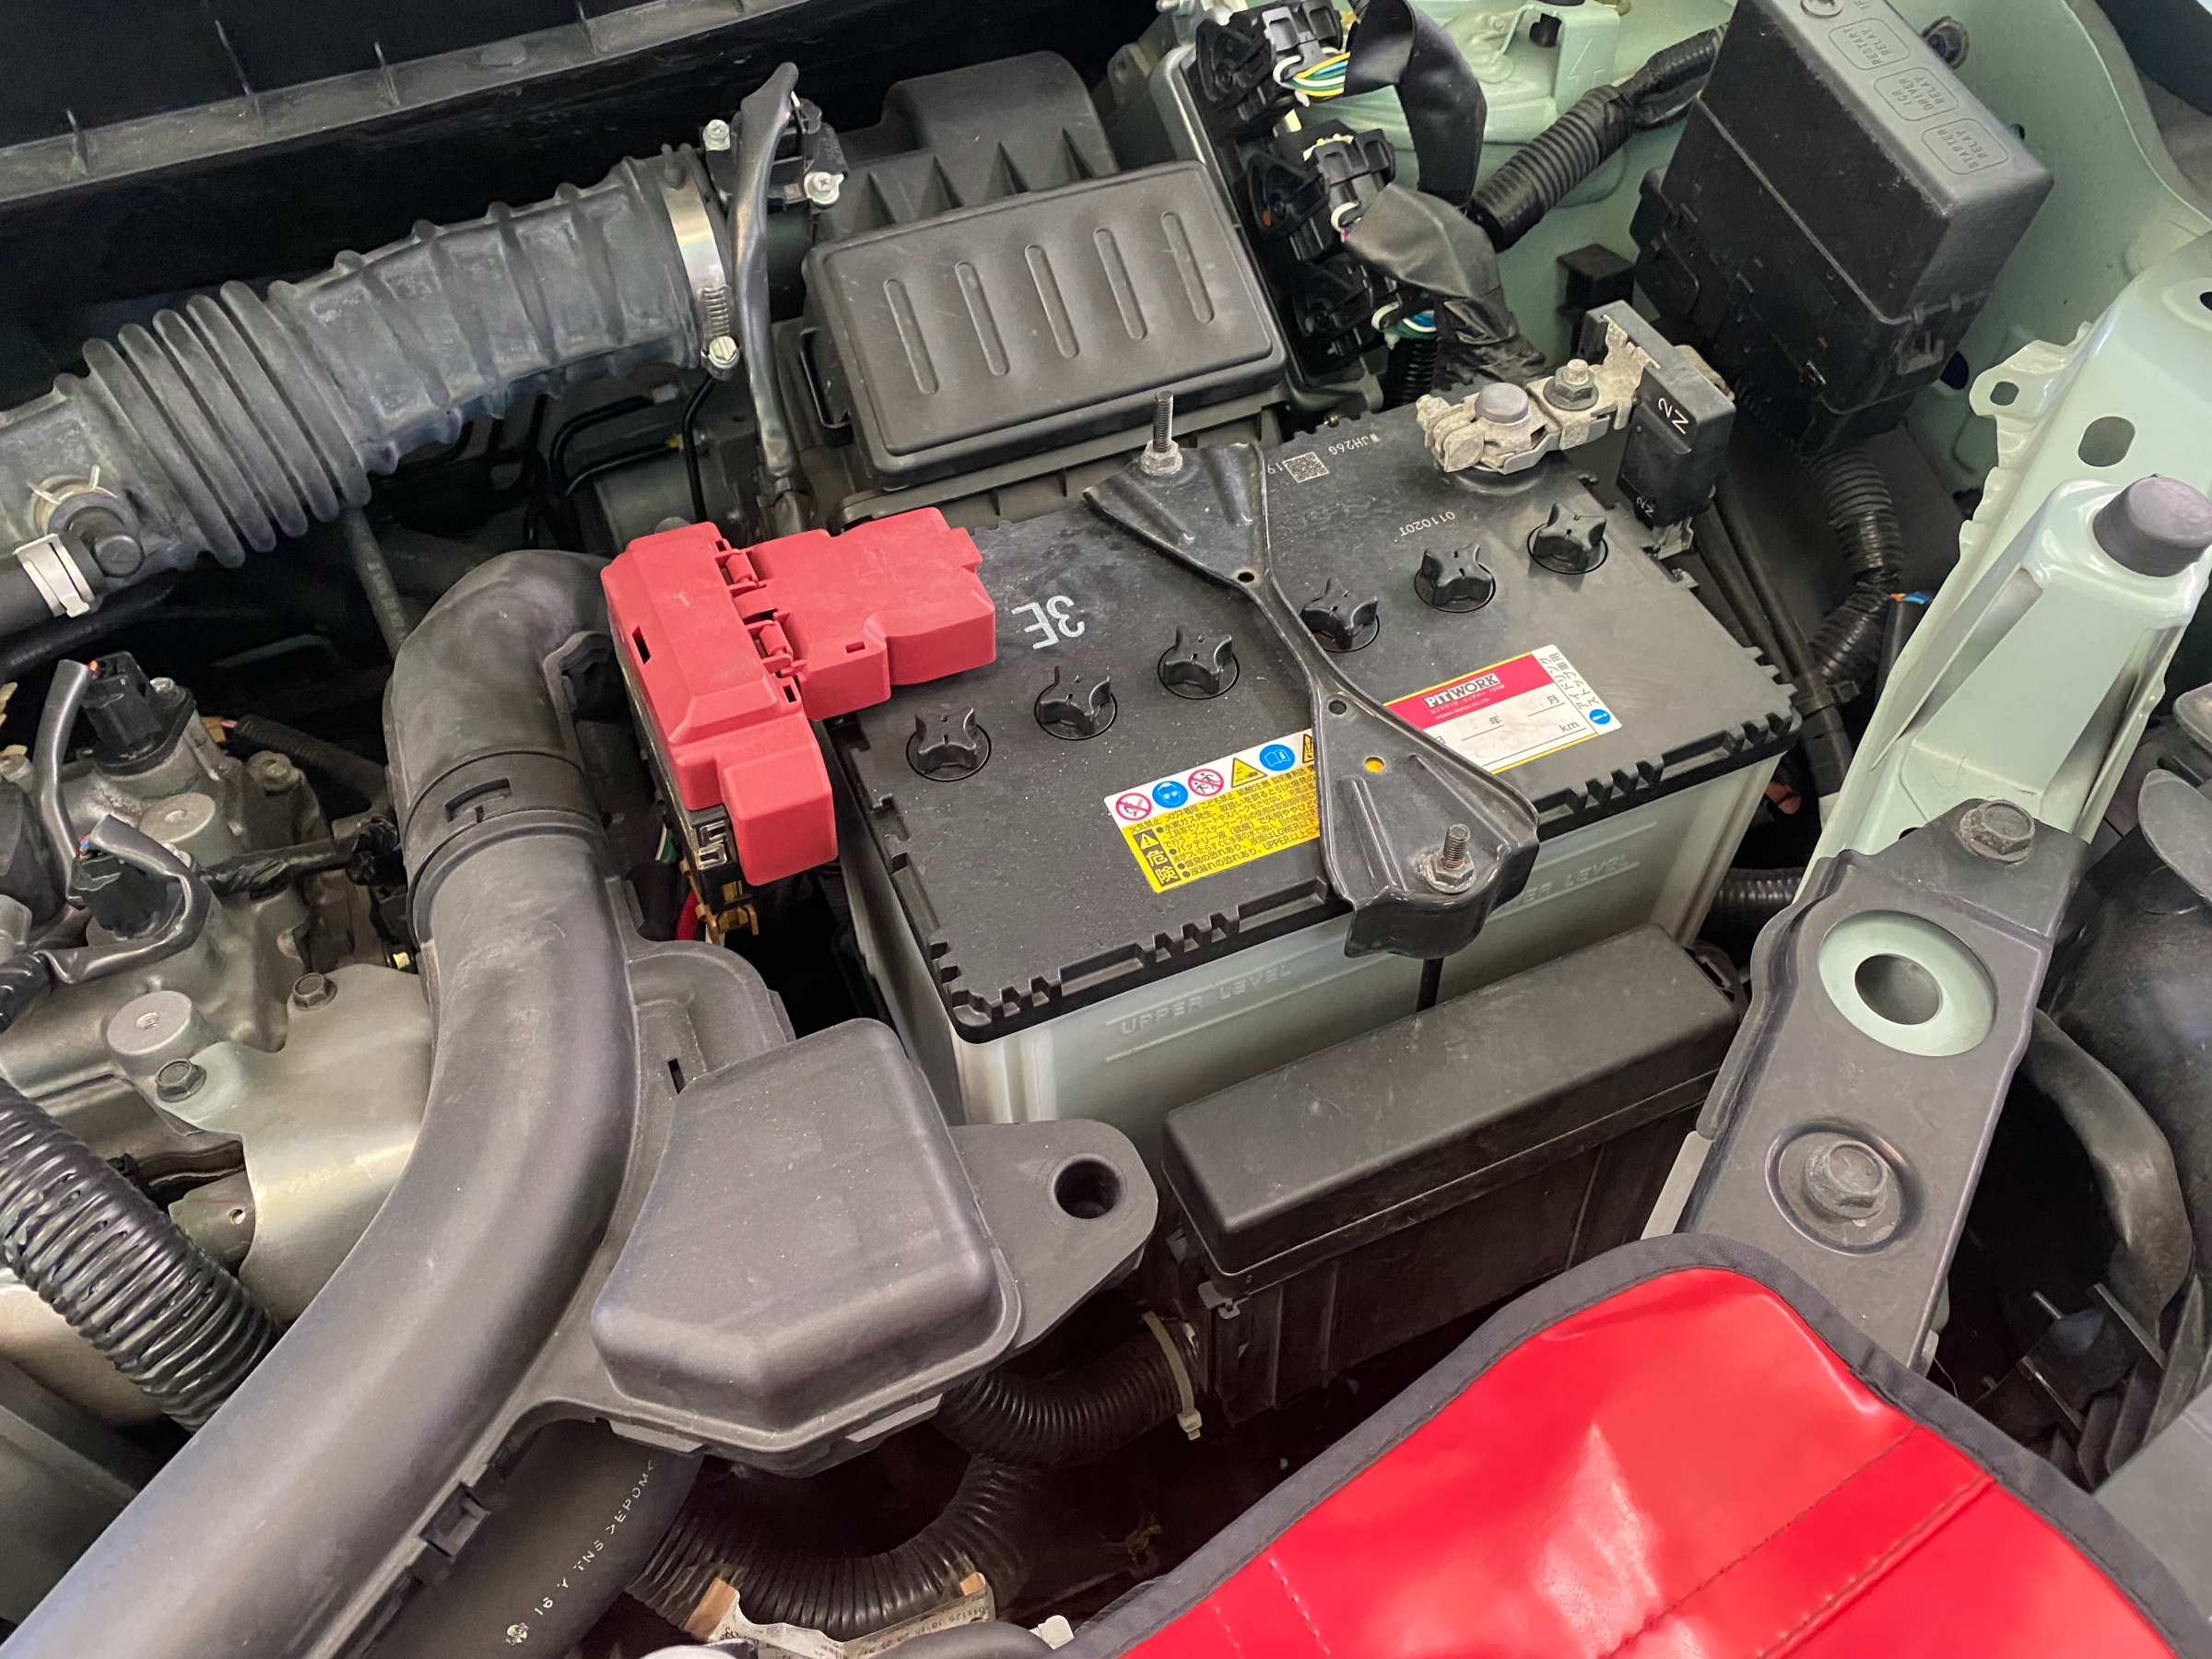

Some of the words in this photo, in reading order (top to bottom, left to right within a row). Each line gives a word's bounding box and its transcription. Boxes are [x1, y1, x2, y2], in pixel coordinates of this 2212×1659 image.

[1843, 28, 1883, 65] RESTART
[1861, 29, 1892, 55] RELAY
[1900, 78, 1934, 110] DRIVER
[1914, 76, 1946, 104] RELAY
[1937, 129, 1979, 169] STARTER
[1956, 130, 1988, 159] RELAY
[1011, 595, 1085, 649] 3E
[1547, 694, 1559, 704] 月
[1489, 715, 1502, 725] 年
[1559, 722, 1580, 733] km
[1128, 817, 1161, 833] 火気禁止
[1143, 847, 1179, 884] 危険
[1122, 995, 1203, 1035] UPPER
[1218, 964, 1291, 1001] LEVEL
